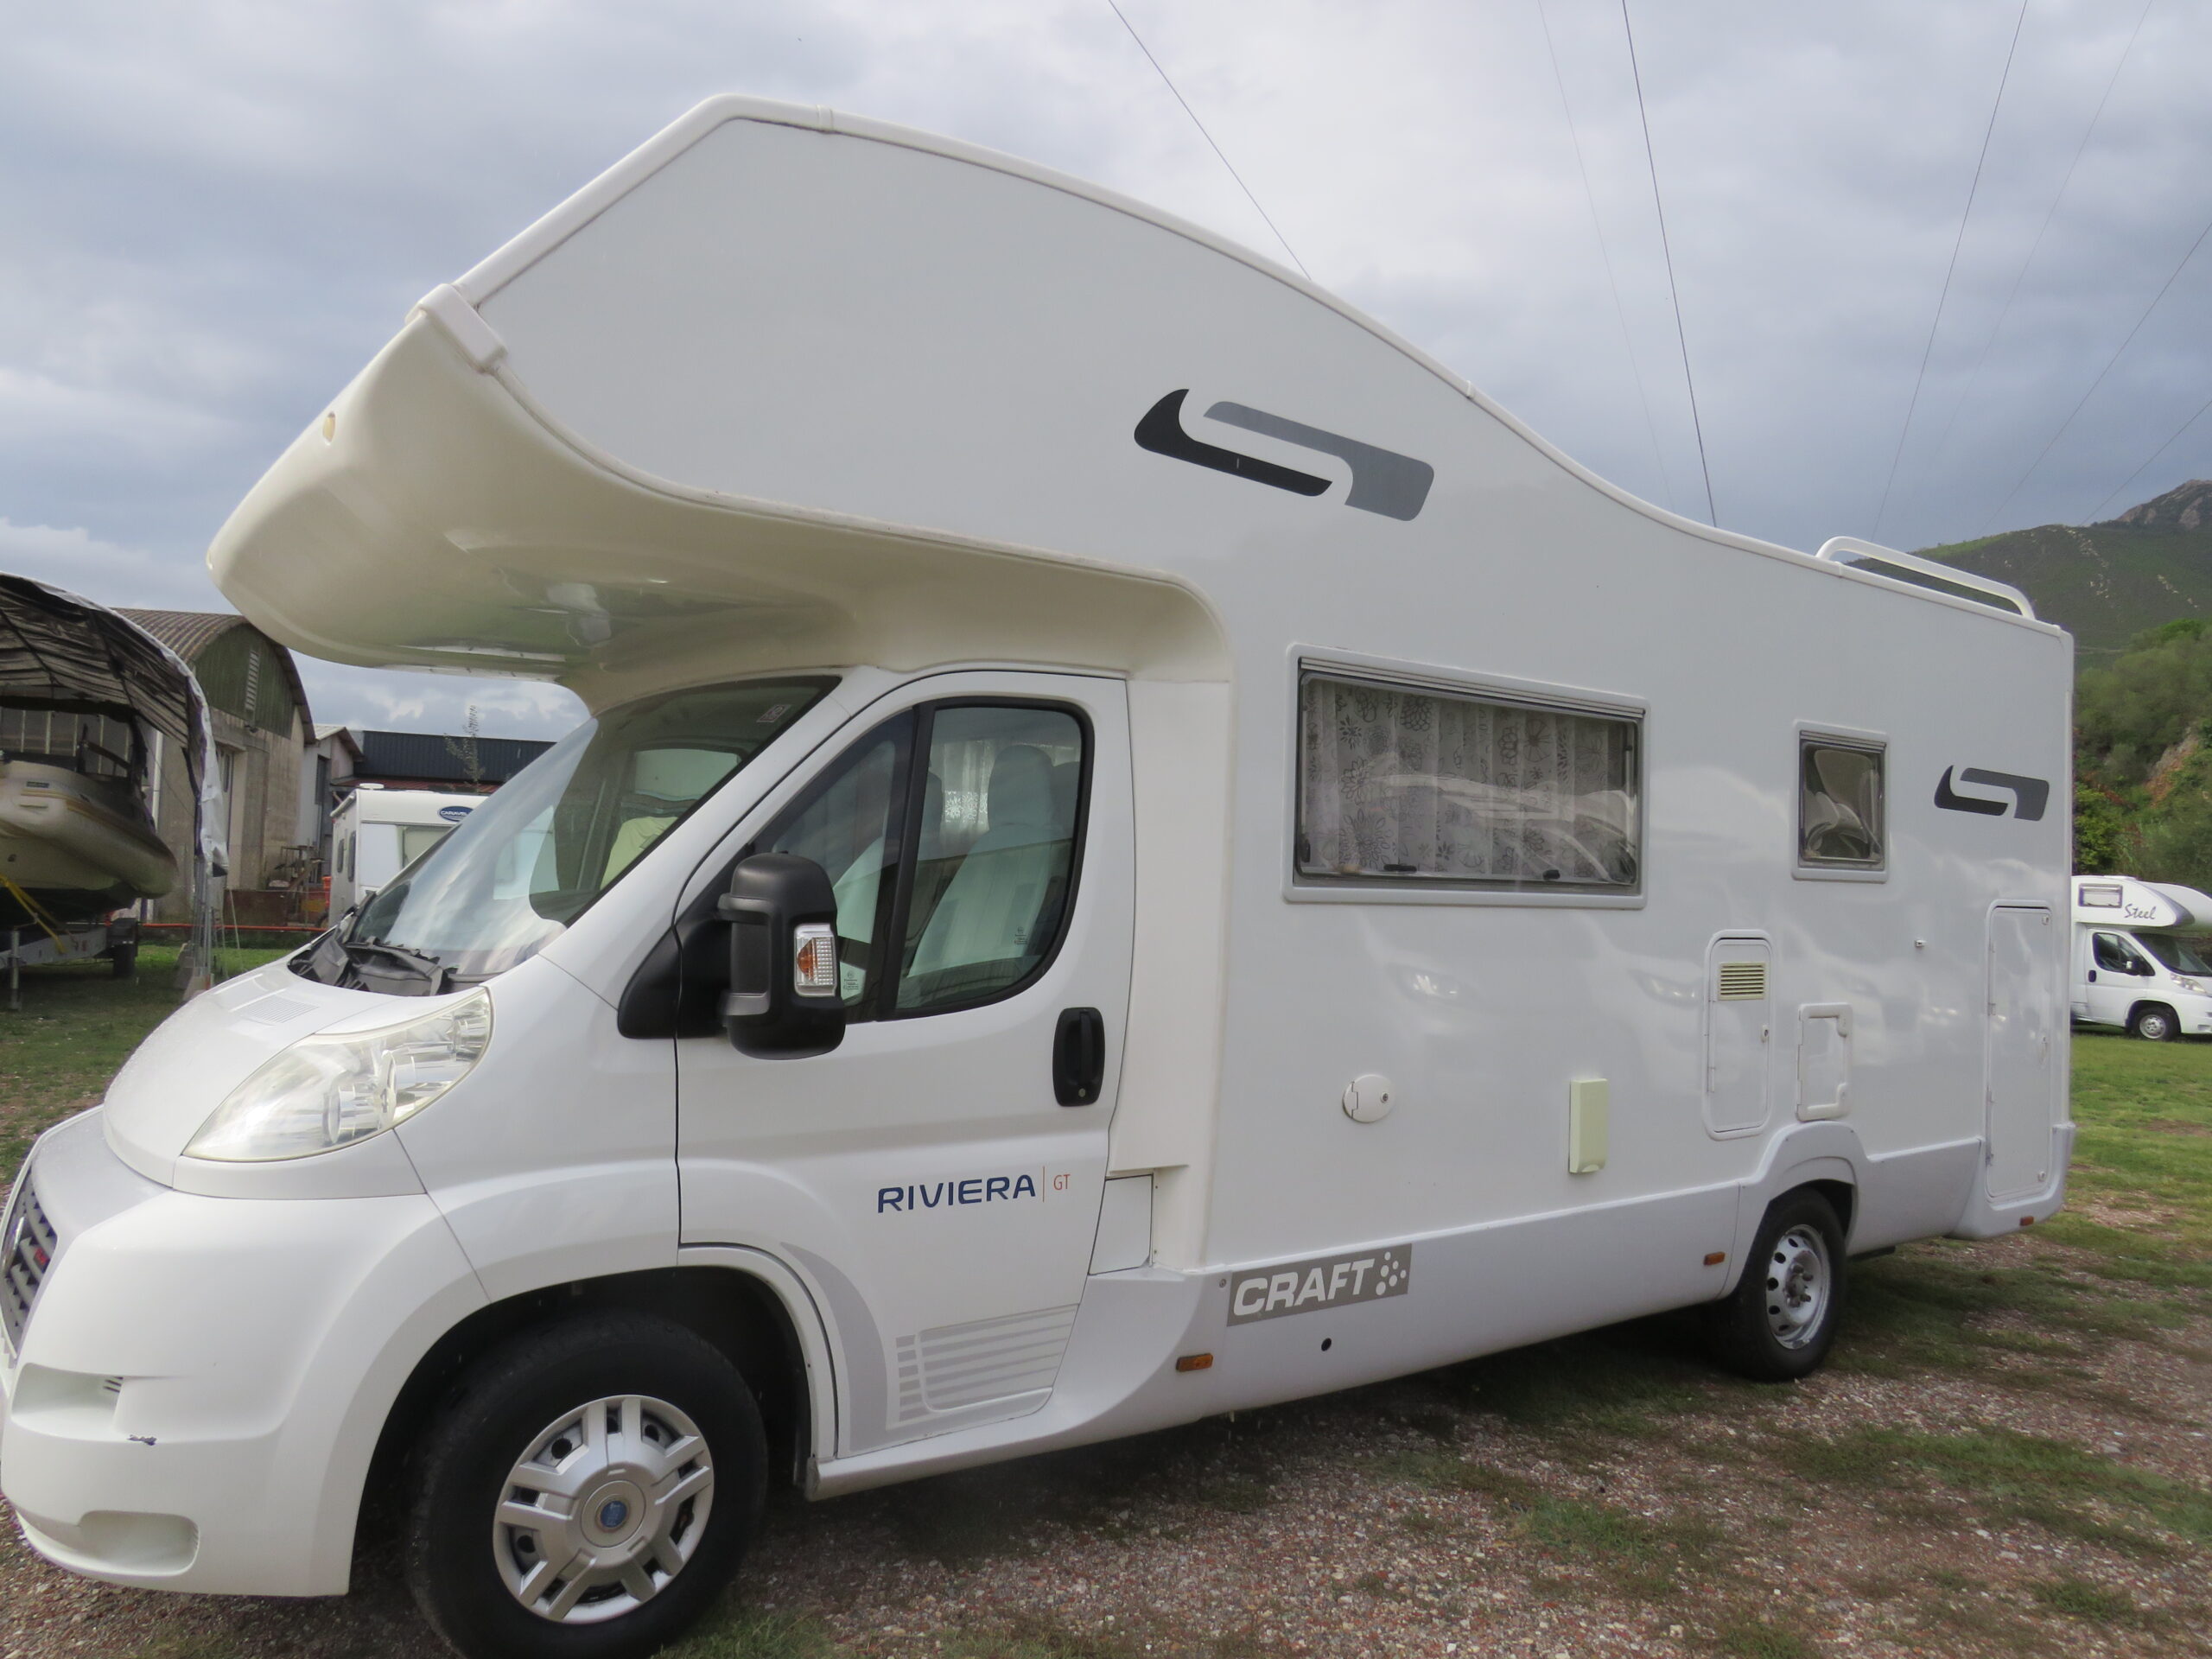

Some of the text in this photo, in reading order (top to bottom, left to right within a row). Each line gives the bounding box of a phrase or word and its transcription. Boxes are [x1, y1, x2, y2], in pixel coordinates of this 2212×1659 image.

[2124, 903, 2157, 920] Steel
[877, 1173, 1071, 1214] RIVIERA GT
[1233, 1258, 1376, 1317] CRAFT
